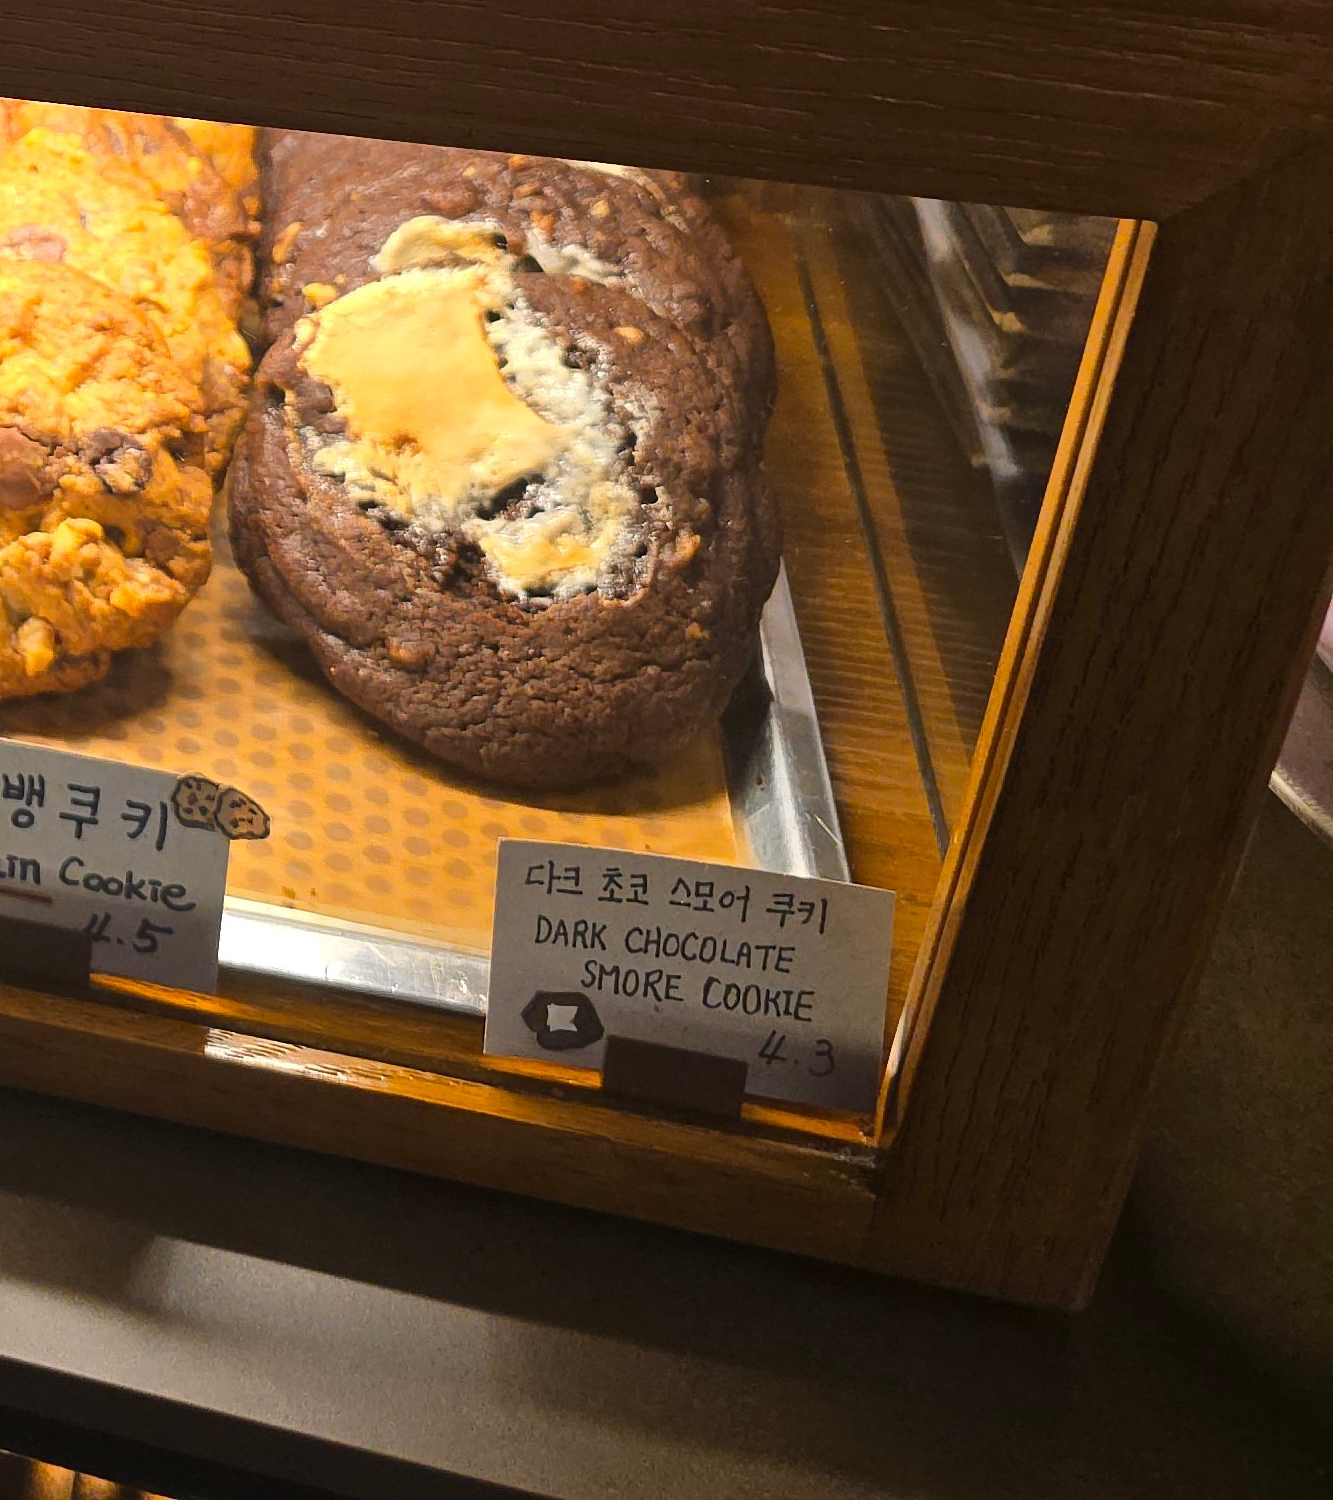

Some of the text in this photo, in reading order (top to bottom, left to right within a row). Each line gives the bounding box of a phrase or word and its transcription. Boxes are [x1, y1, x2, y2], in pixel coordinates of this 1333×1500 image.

[58, 856, 196, 911] Cookie
[524, 860, 828, 935] 다크 초코 스모어 쿠키
[84, 913, 174, 954] 4.5
[534, 914, 796, 974] DARK CHOCOLATE
[580, 960, 815, 1023] SMORE COOKIE
[757, 1030, 834, 1076] 4.3
